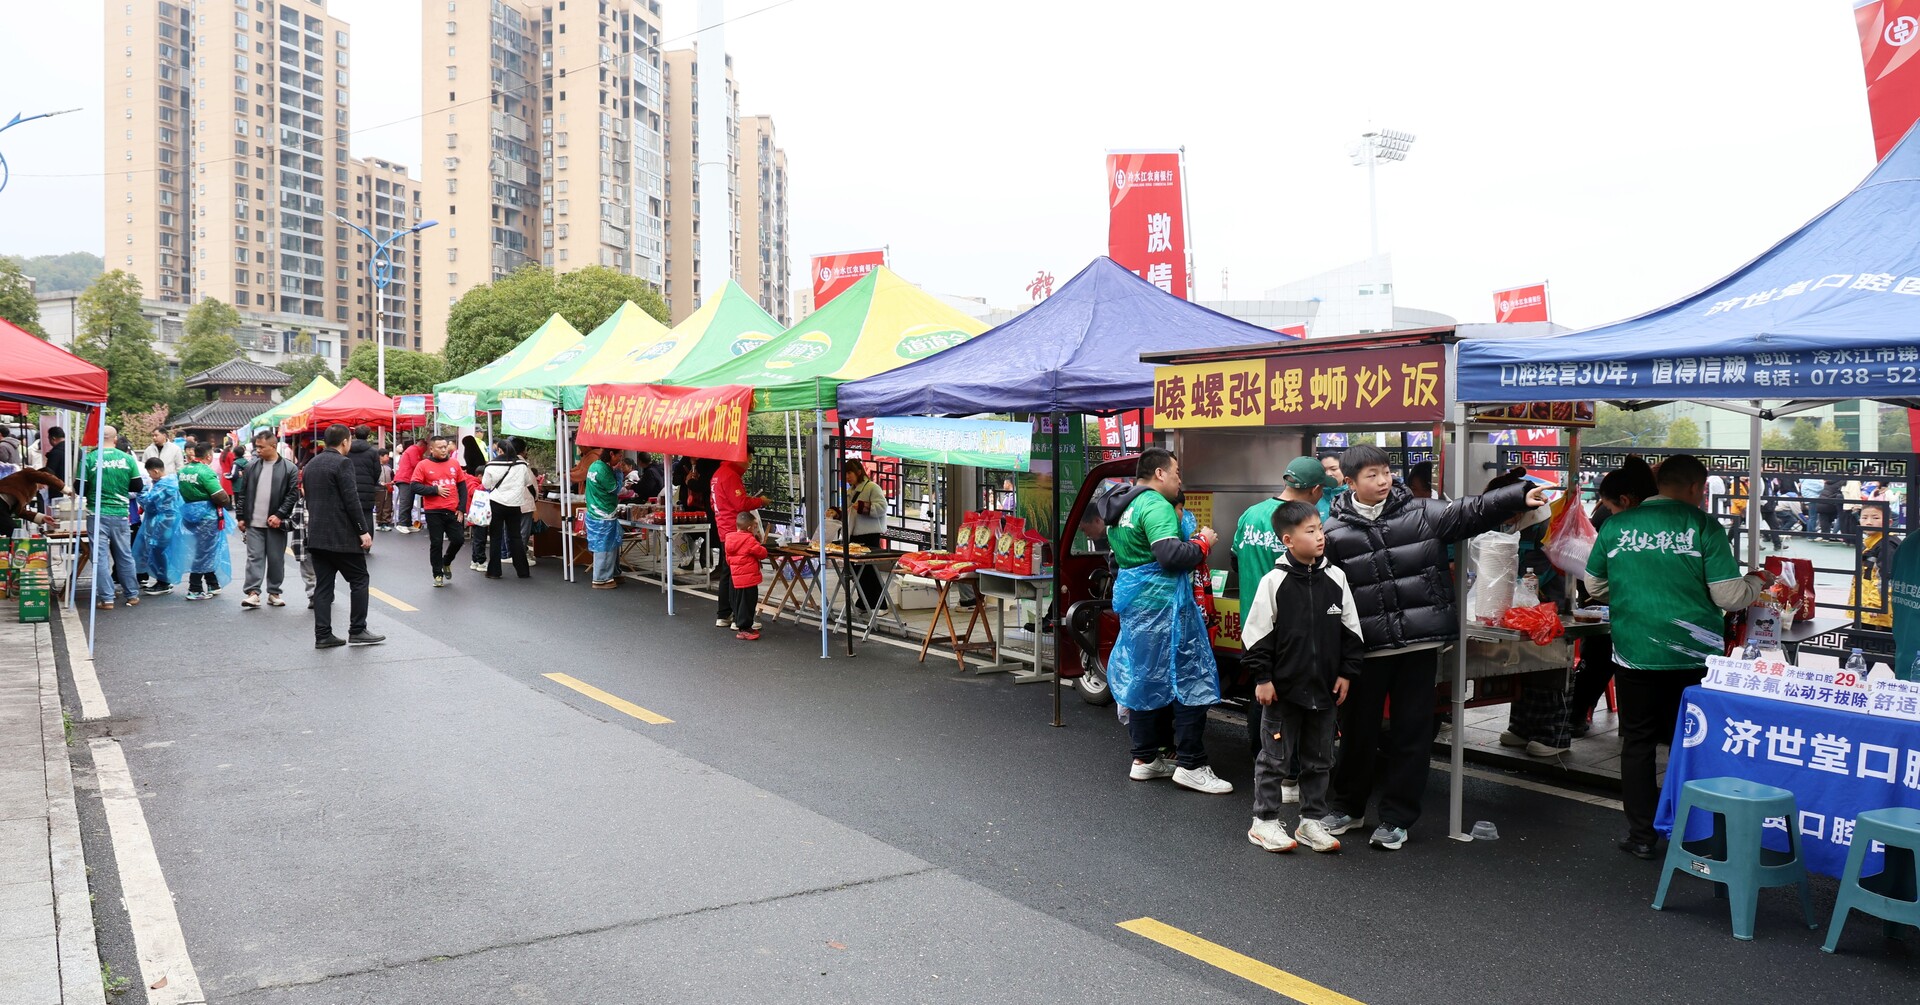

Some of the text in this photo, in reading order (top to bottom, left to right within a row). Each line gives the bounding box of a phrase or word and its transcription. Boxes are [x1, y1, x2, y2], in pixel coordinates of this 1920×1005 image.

[1154, 361, 1439, 421] 嗦螺张 螺蛳炒饭
[1709, 657, 1786, 678] 济世堂口腔 免费
[1786, 668, 1834, 684] 济世堂口腔
[1835, 673, 1856, 687] 29
[1705, 669, 1781, 695] 儿童涂氟
[1784, 682, 1869, 709] 松动牙拔除
